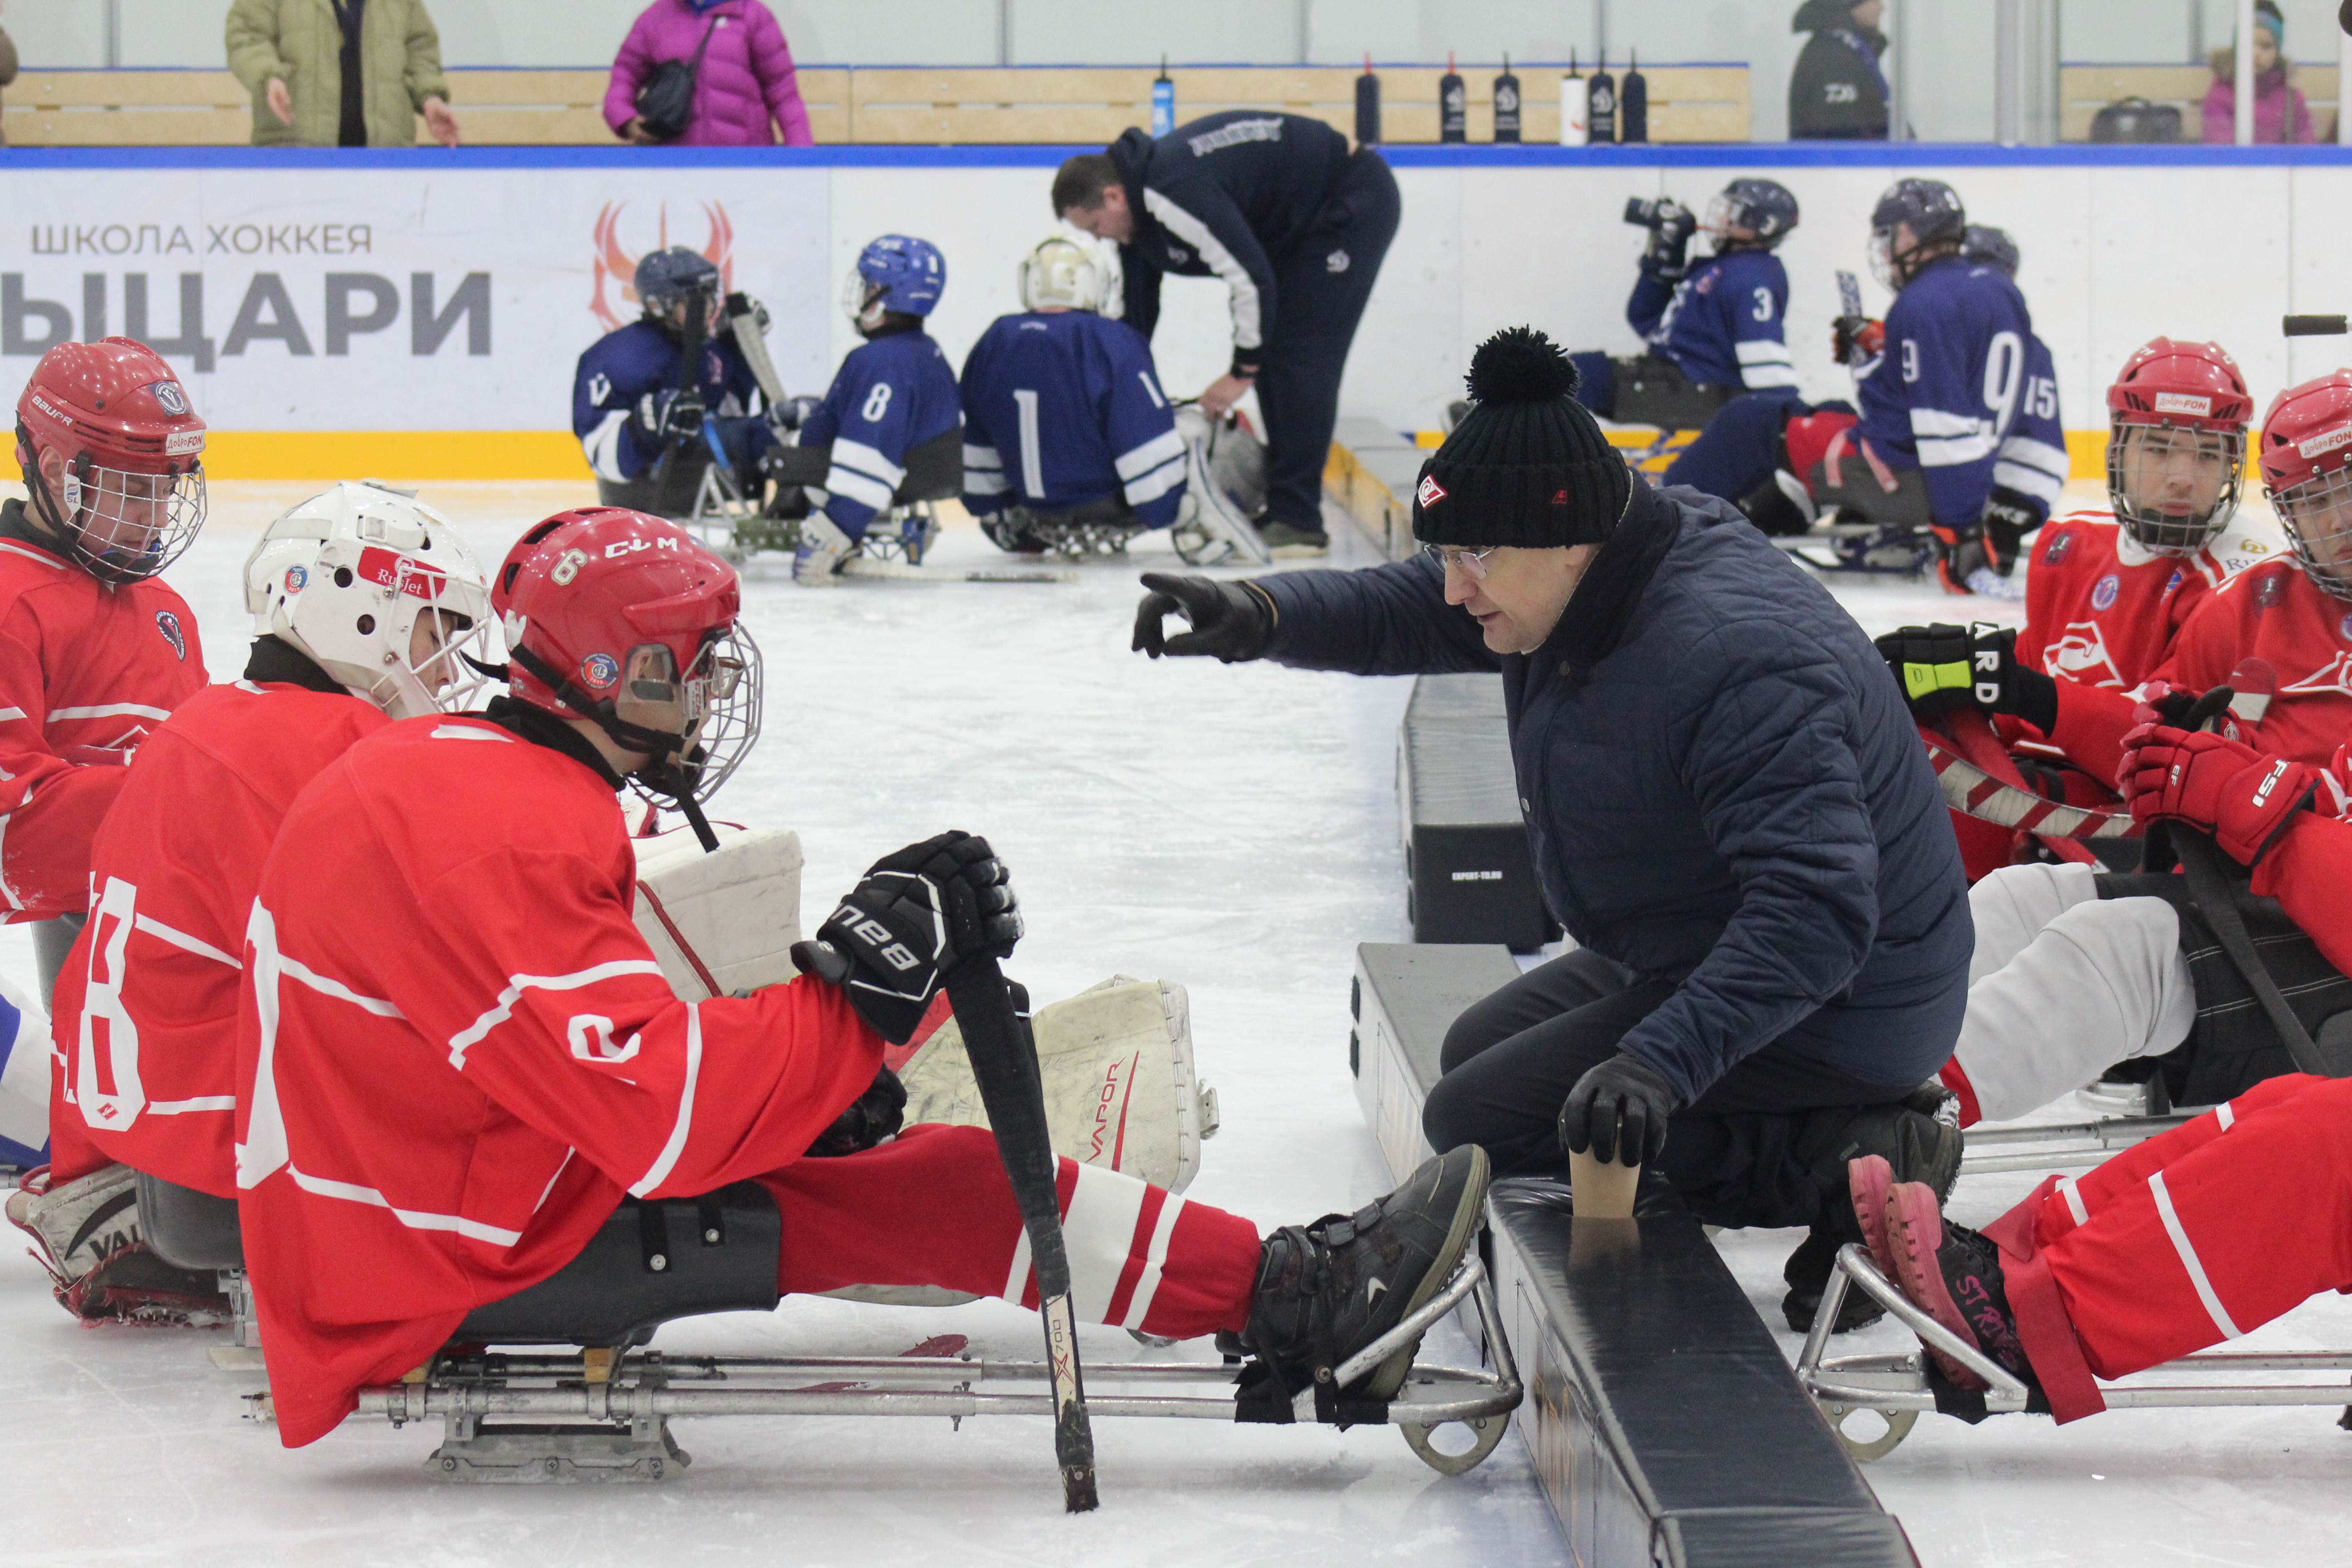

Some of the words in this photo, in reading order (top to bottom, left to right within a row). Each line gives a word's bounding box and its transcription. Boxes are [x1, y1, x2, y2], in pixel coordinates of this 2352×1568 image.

[32, 224, 193, 255] ШКОЛА
[206, 224, 372, 255] ХОККЕЯ
[1752, 287, 1774, 322] 3
[1901, 339, 1921, 382] 9
[862, 382, 892, 422] 8
[2024, 375, 2057, 420] 15
[1014, 389, 1046, 499] 1
[67, 495, 78, 504] SL
[551, 548, 588, 586] 6
[1087, 1056, 1126, 1162] VAPOR
